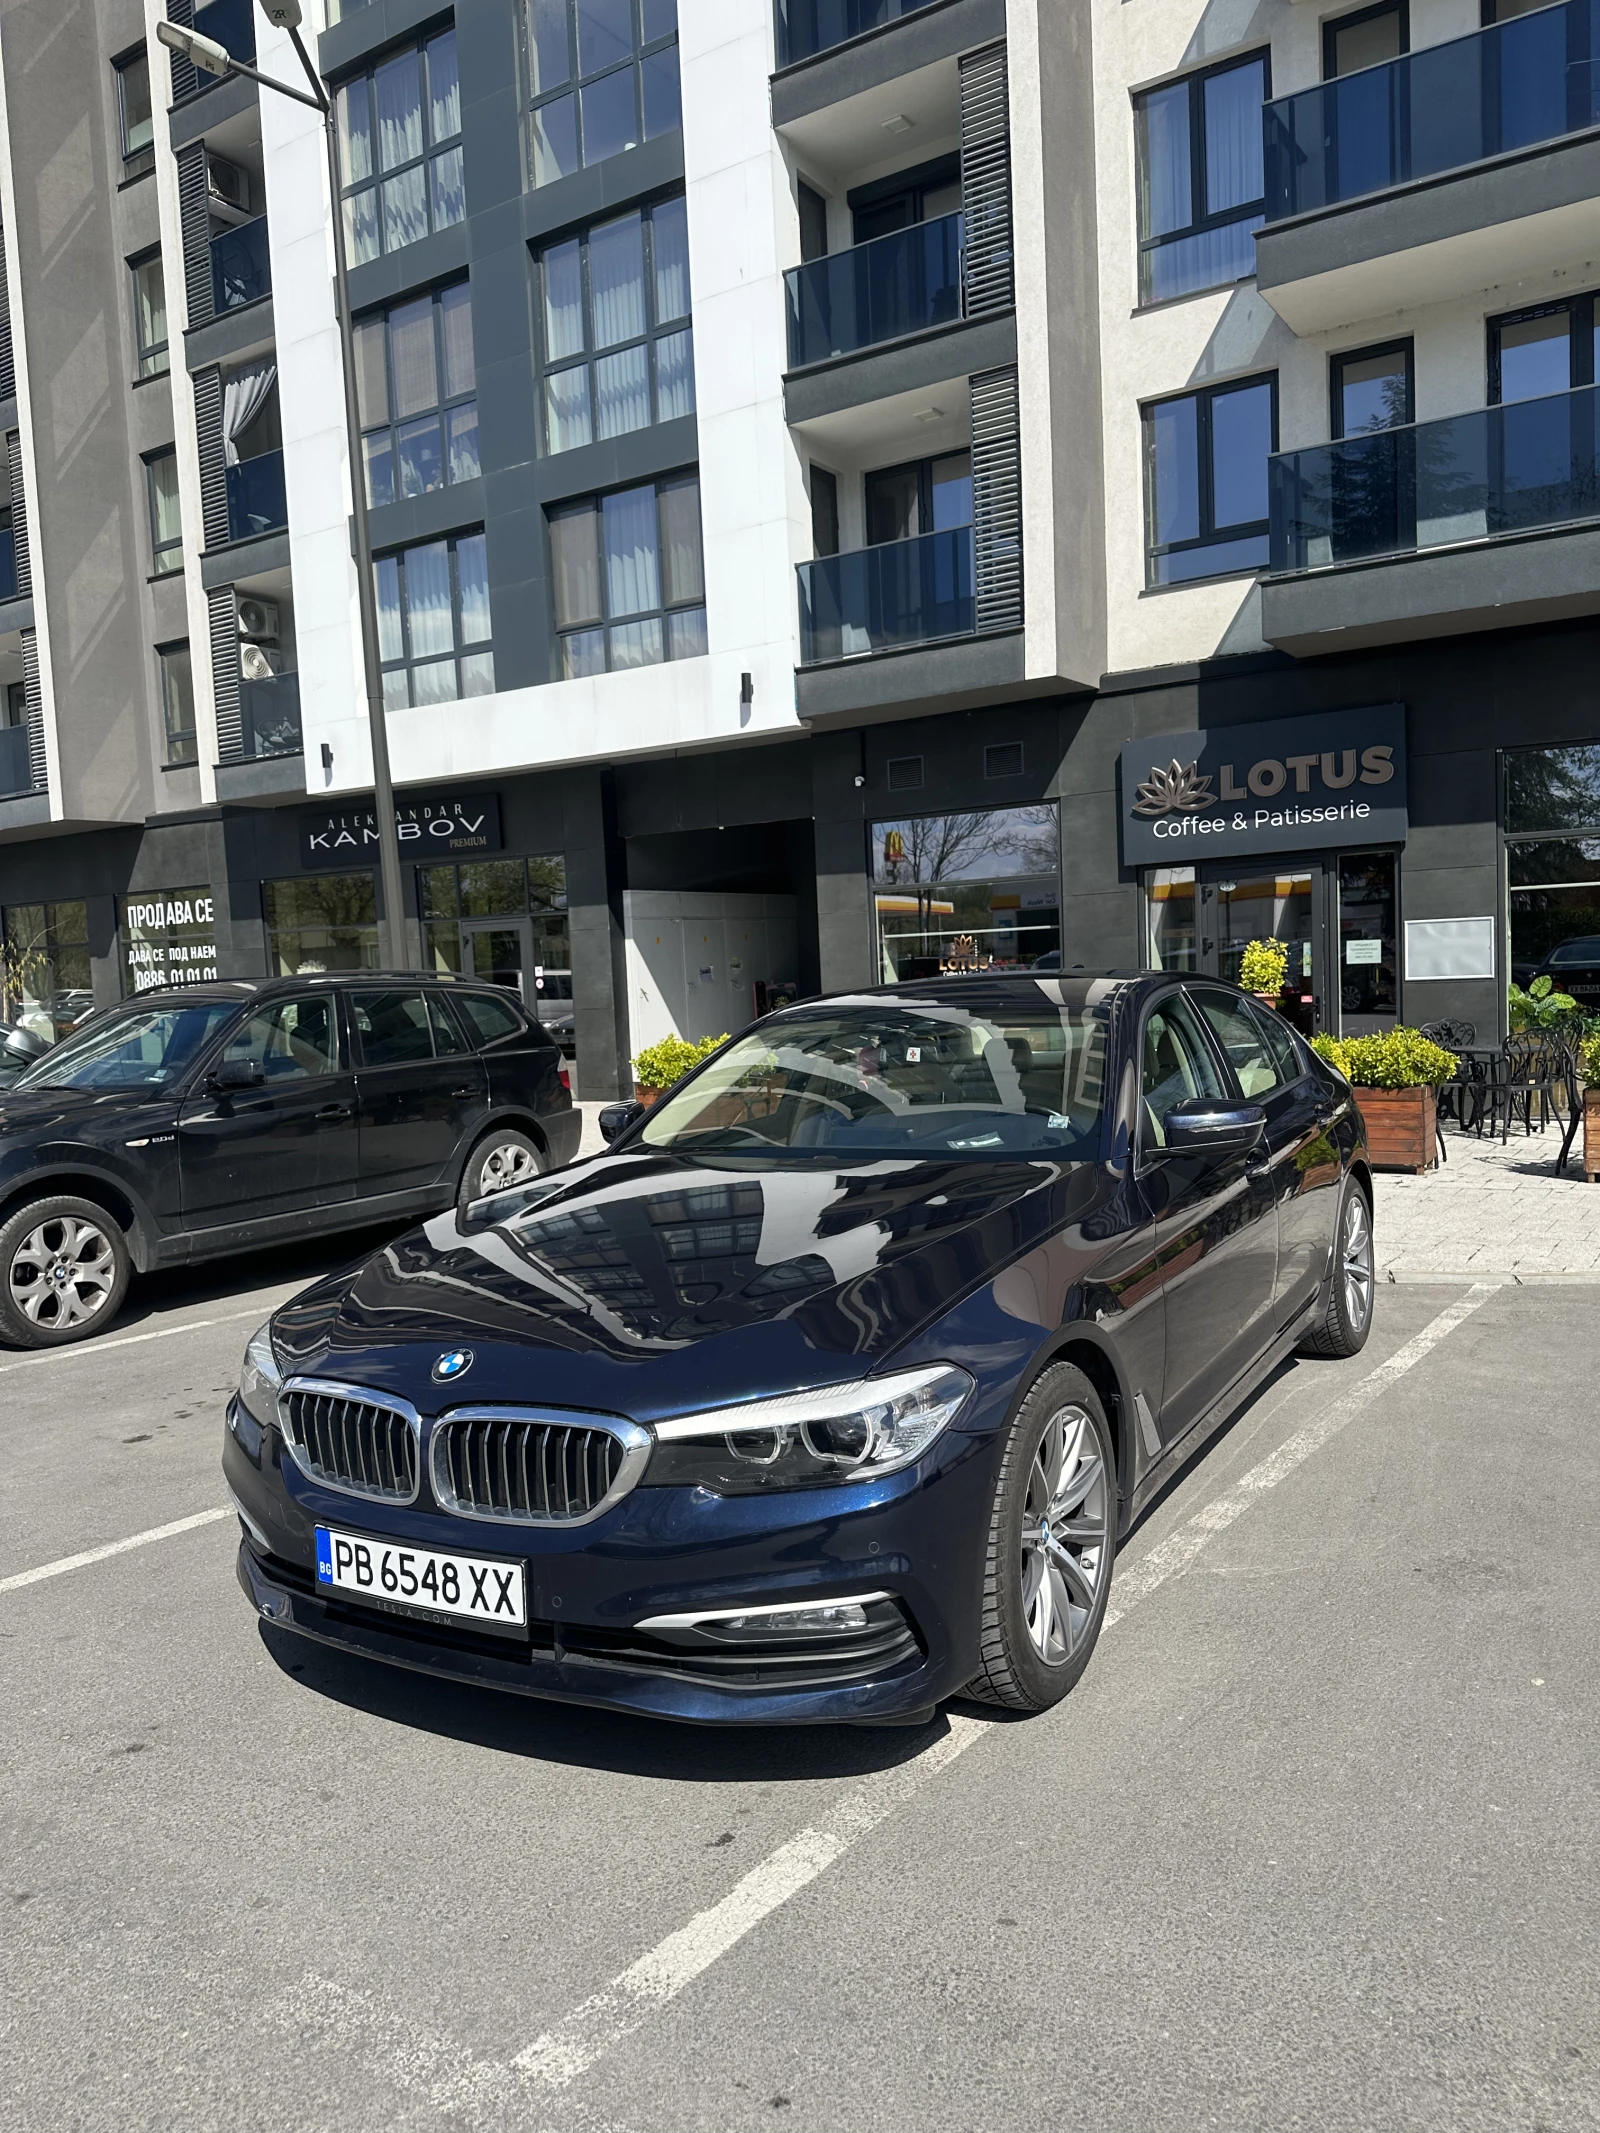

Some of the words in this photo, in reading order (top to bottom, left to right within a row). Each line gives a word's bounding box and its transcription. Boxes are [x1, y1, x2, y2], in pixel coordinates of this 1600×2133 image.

[1220, 745, 1395, 801] LOTUS
[328, 803, 463, 830] ALEKANDAR
[1153, 815, 1226, 838] Coffee
[1231, 812, 1248, 830] &
[1254, 799, 1371, 829] Patisserie
[309, 814, 486, 850] KAMBOV
[449, 835, 488, 849] PREMIUM
[127, 900, 194, 930] ПРОДАВА
[195, 898, 215, 923] СЕ
[128, 949, 152, 965] ДАВА
[153, 948, 165, 962] СЕ
[168, 946, 189, 962] ПОД
[190, 944, 217, 959] НАЕМ
[939, 956, 989, 971] LOTUS
[136, 969, 166, 991] 0886
[319, 1560, 332, 1576] BG
[335, 1539, 374, 1587] PB
[380, 1550, 461, 1605] 6548
[468, 1565, 516, 1616] XX
[376, 1601, 453, 1626] TESLA.COM
